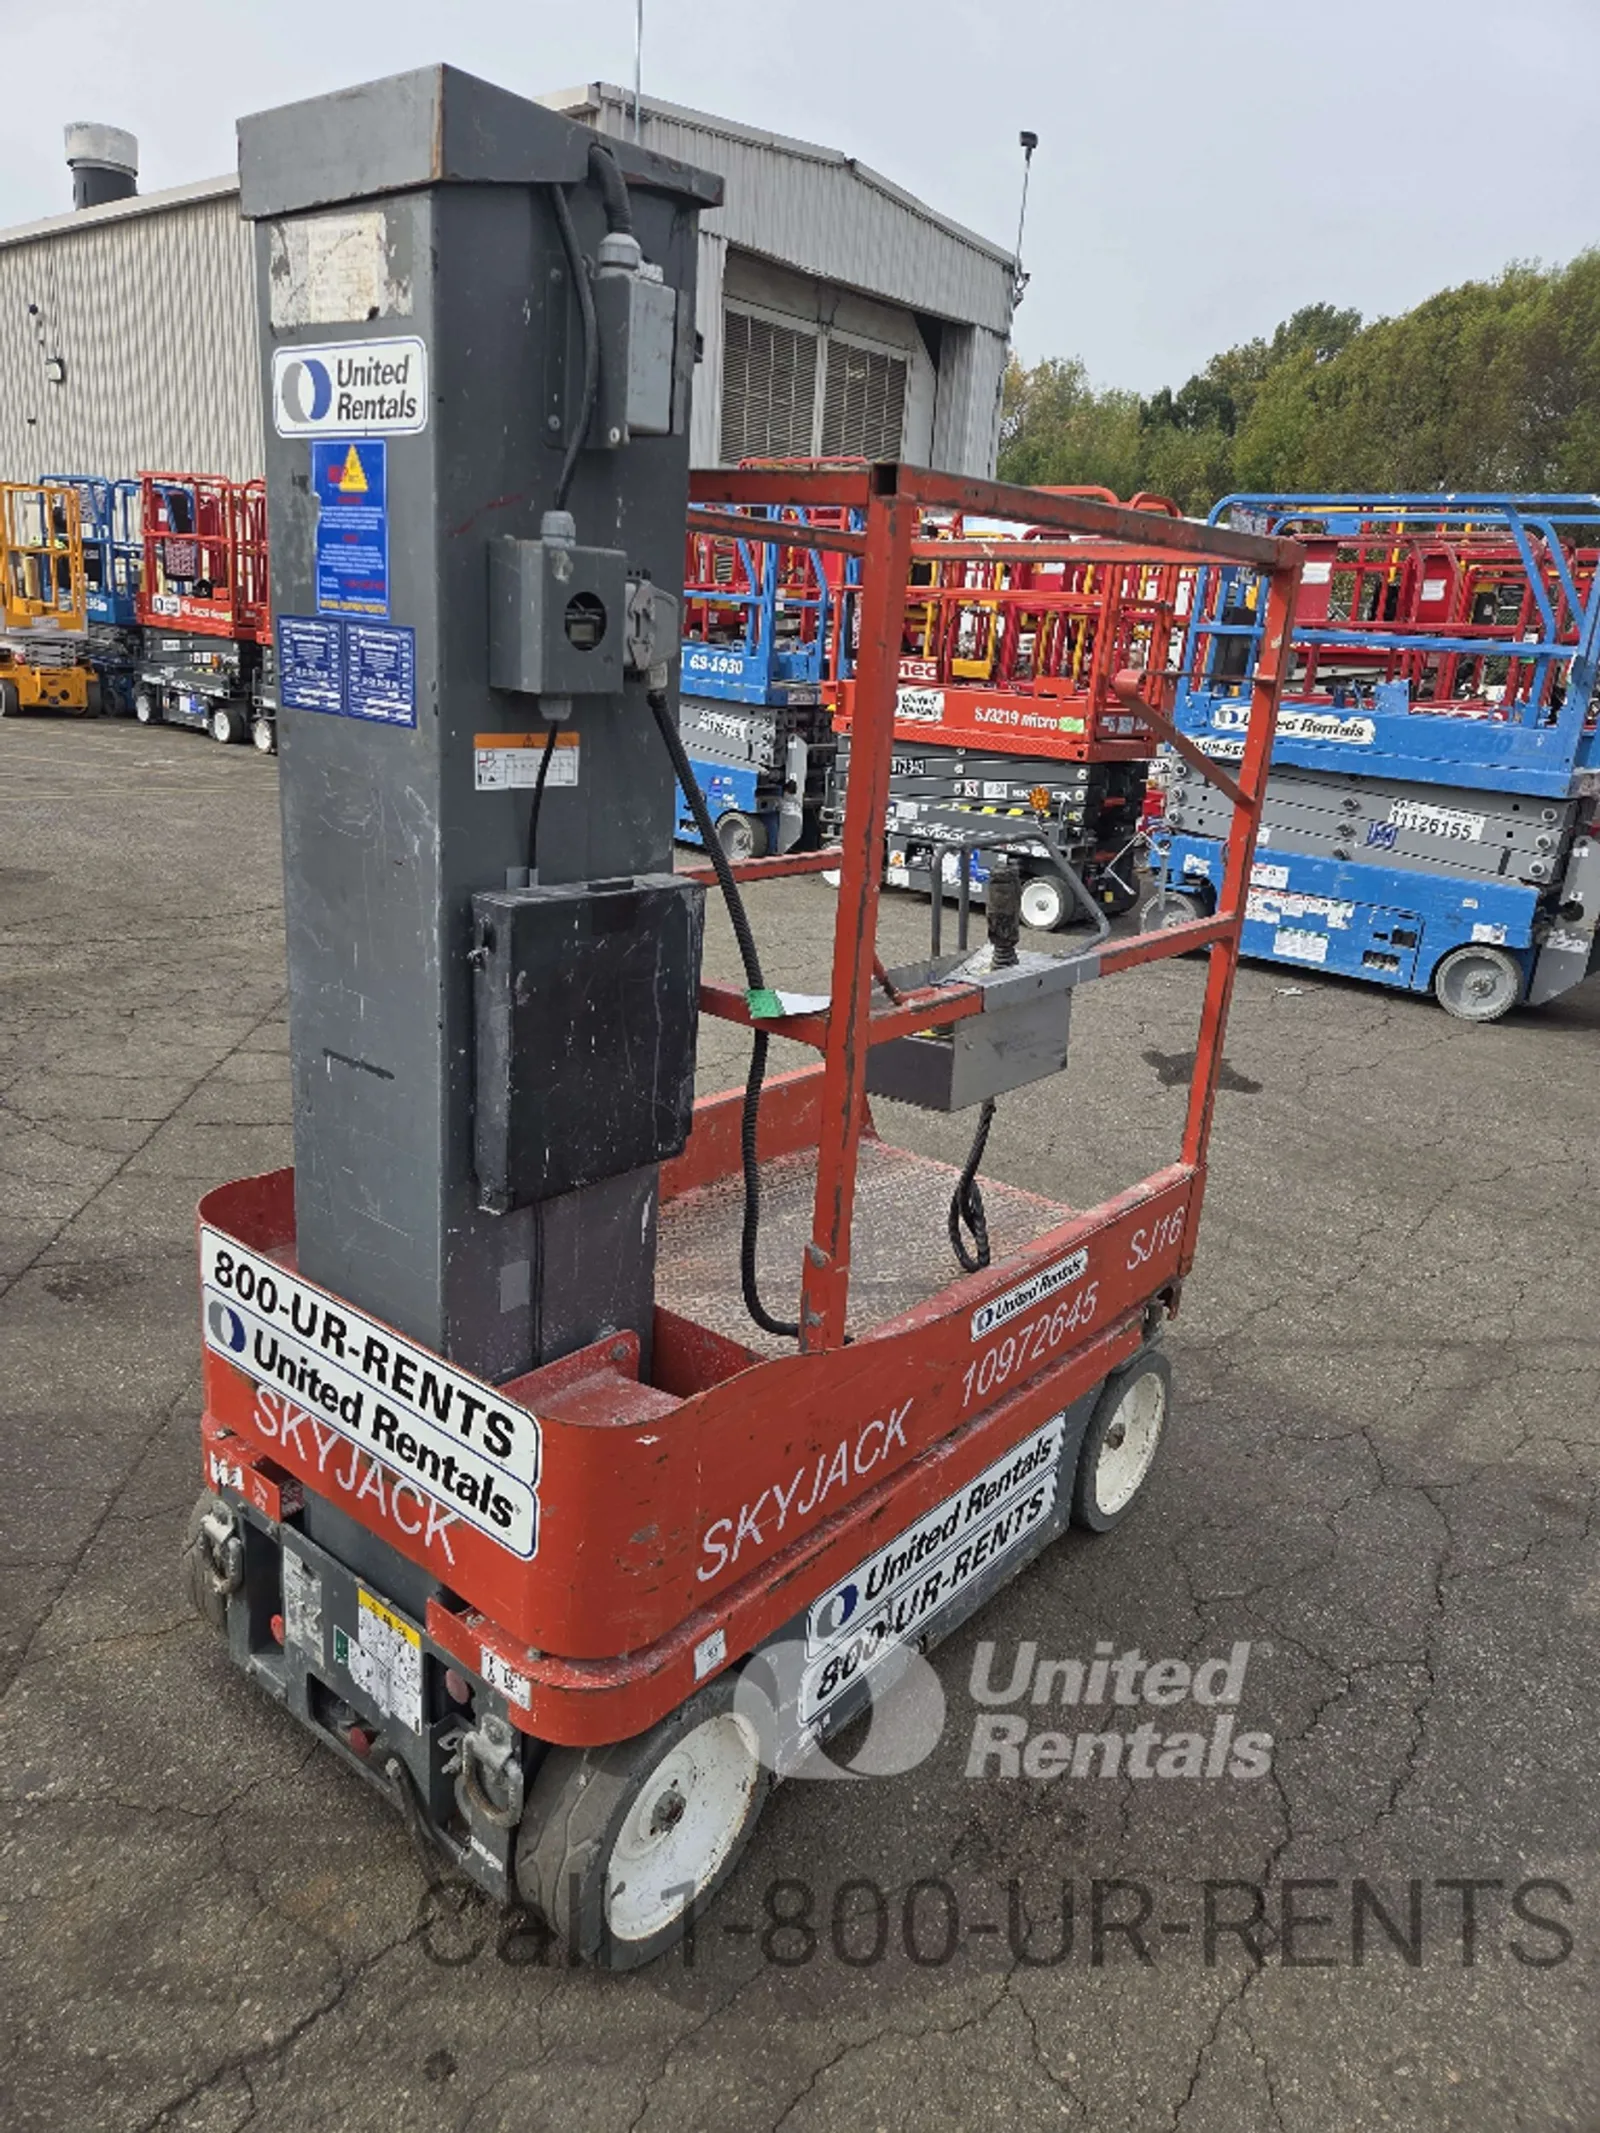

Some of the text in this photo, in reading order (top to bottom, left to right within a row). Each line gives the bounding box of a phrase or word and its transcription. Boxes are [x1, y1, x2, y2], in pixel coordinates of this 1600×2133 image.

[337, 354, 410, 388] United
[337, 390, 417, 421] Rentals
[689, 654, 743, 675] GS-1930
[974, 706, 1058, 730] SJ3219 micro
[1300, 718, 1366, 738] Rentals
[1126, 1206, 1186, 1271] SJ16
[994, 1258, 1083, 1320] United Rentals
[213, 1250, 515, 1460] 800-UR-RENTS
[961, 1281, 1099, 1408] 10972645
[253, 1329, 515, 1529] United Rentals
[253, 1384, 460, 1566] SKYJACK
[696, 1397, 914, 1582] SKYJACK
[864, 1433, 1054, 1601] United Rentals
[816, 1487, 1046, 1701] 800UR-RENTS
